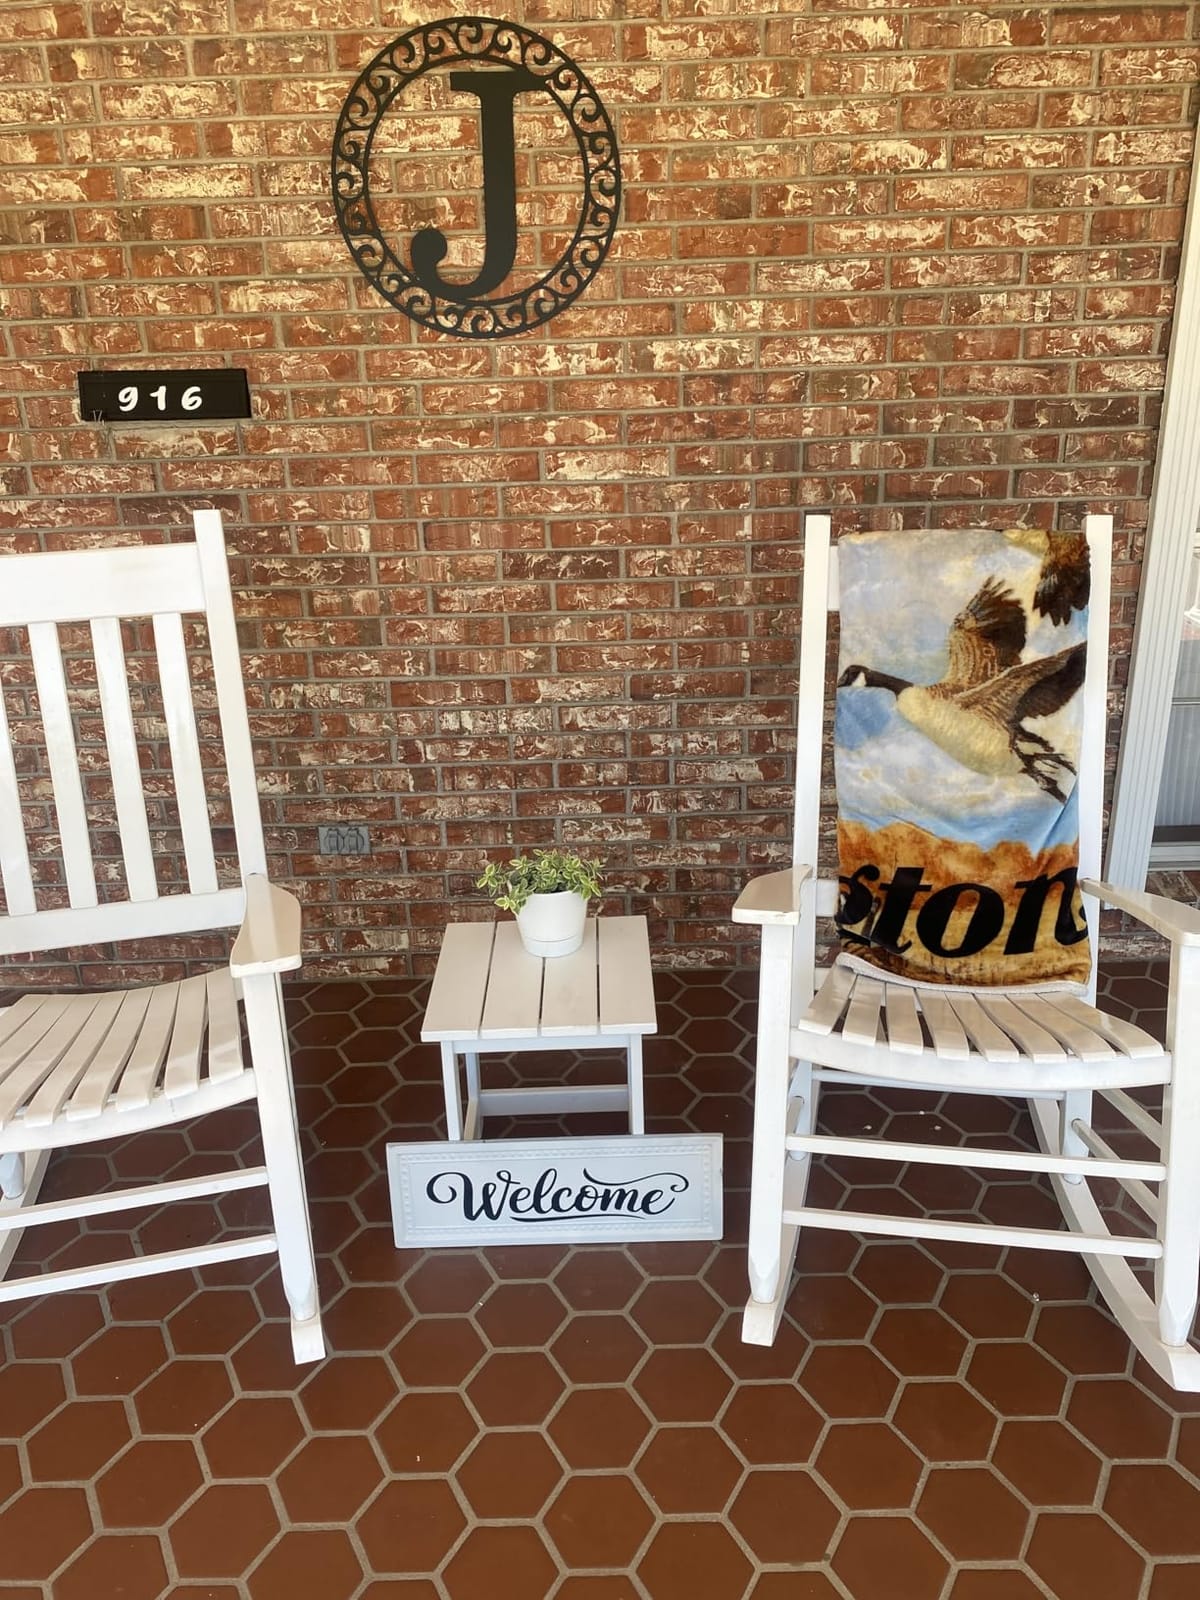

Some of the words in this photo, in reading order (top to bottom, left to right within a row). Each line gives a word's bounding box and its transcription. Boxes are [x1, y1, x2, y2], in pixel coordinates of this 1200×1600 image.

[411, 71, 549, 299] J
[118, 385, 202, 412] 916
[837, 864, 1088, 958] ston
[426, 1167, 689, 1222] Welcome
